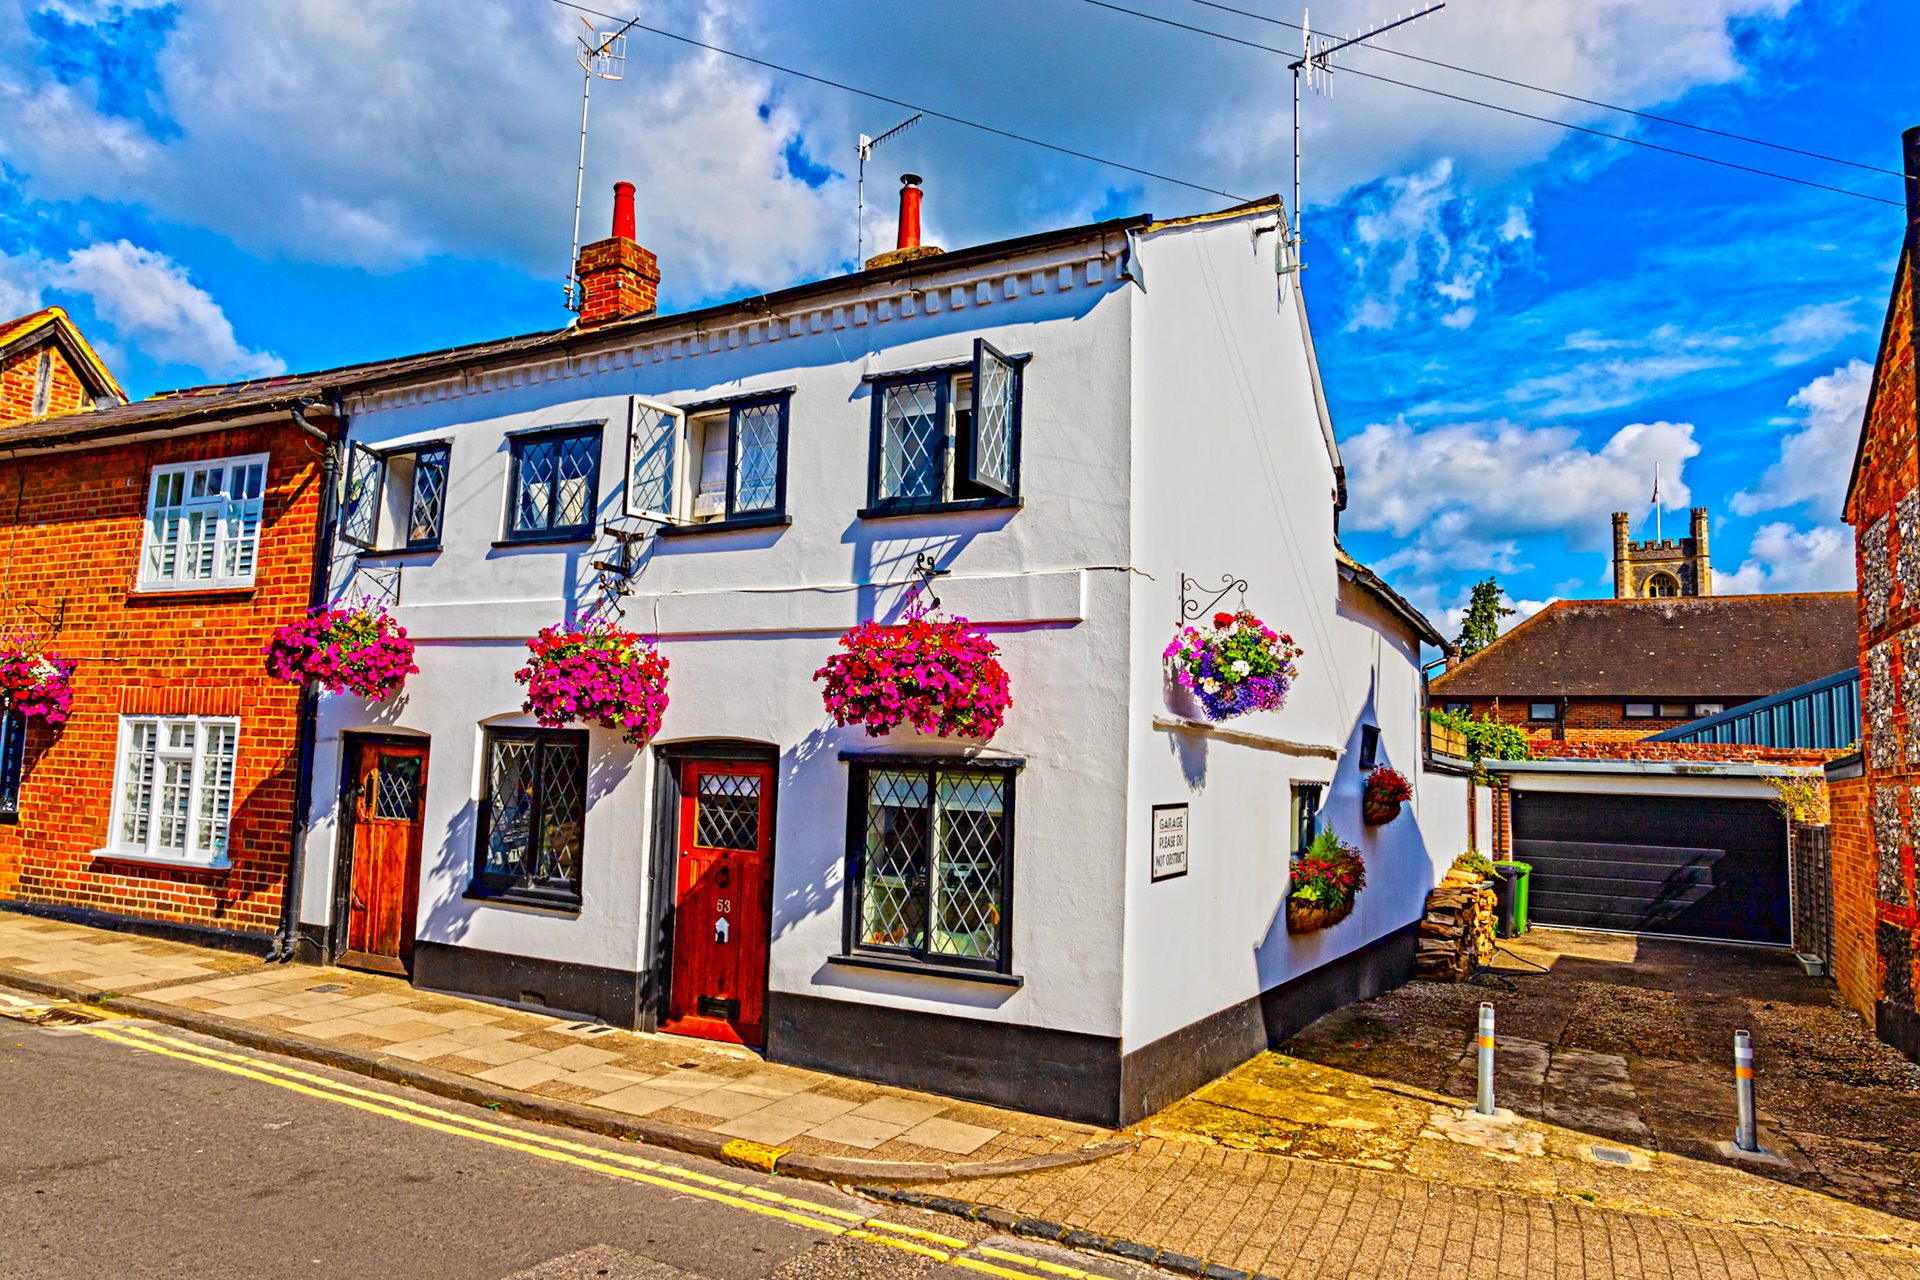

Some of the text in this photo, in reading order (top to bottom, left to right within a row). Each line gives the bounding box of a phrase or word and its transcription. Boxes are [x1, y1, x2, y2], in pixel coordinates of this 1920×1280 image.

[1159, 817, 1183, 830] GARAGE
[1159, 834, 1183, 849] PLEASE DO
[1156, 851, 1185, 867] NOT OBSTRUCT
[716, 899, 731, 913] 53
